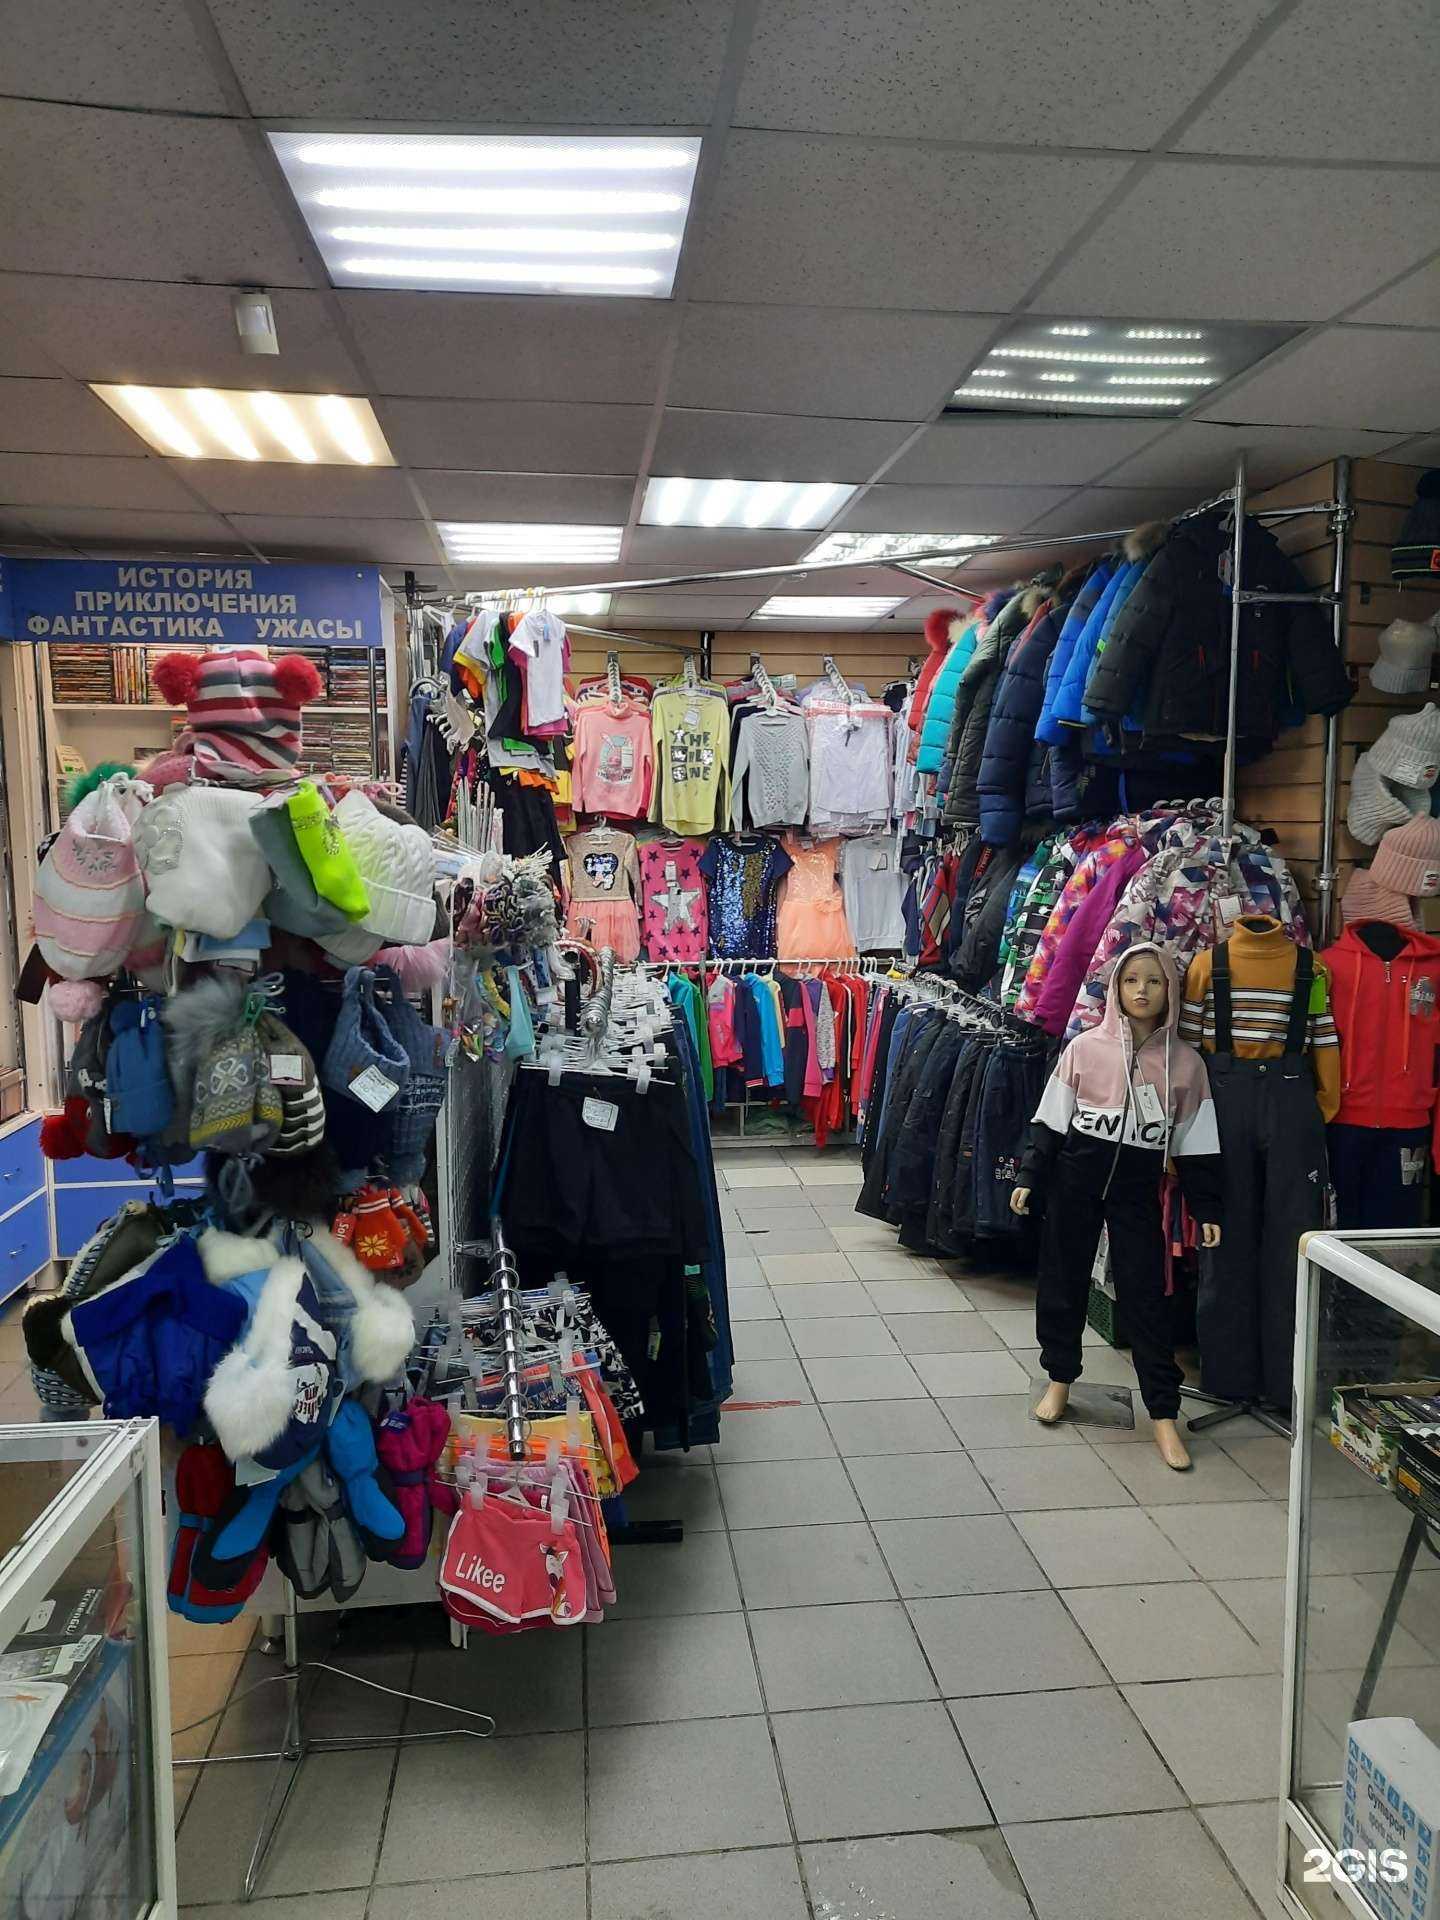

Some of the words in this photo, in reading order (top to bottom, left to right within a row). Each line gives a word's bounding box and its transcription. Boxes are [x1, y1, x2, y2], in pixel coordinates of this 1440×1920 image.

[118, 568, 252, 589] ИСТОРИЯ
[75, 591, 297, 614] ПРИКЛЮЧЕНИЯ
[27, 615, 224, 639] ФАНТАСТИКА
[256, 617, 362, 640] УЖАСЫ
[455, 1552, 506, 1593] Likee
